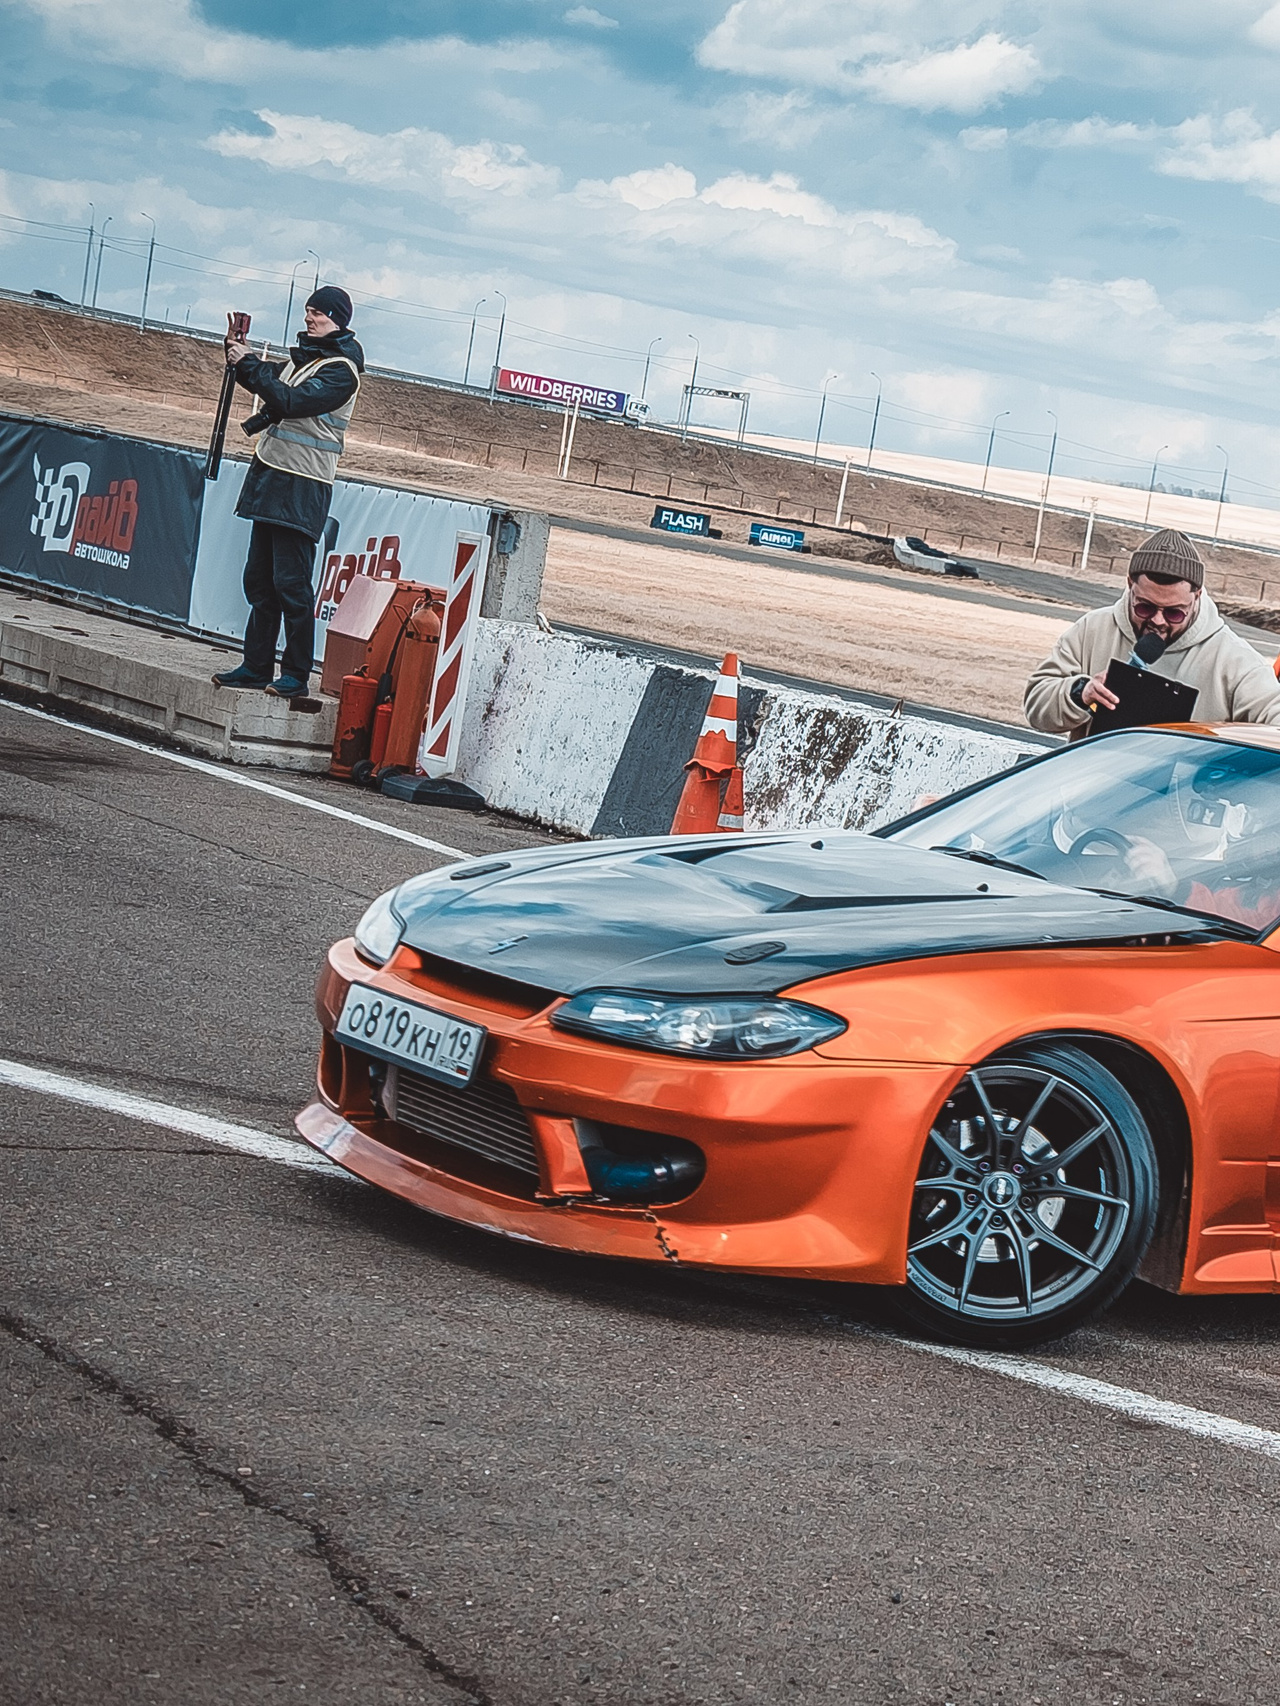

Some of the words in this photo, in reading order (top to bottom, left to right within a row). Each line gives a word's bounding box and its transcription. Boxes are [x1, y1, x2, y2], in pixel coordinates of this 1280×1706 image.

[509, 373, 617, 409] WILDBERRIES
[660, 510, 704, 531] FLASH
[761, 531, 793, 546] AIMOL
[74, 542, 131, 570] автошкола
[449, 1026, 471, 1060] 19
